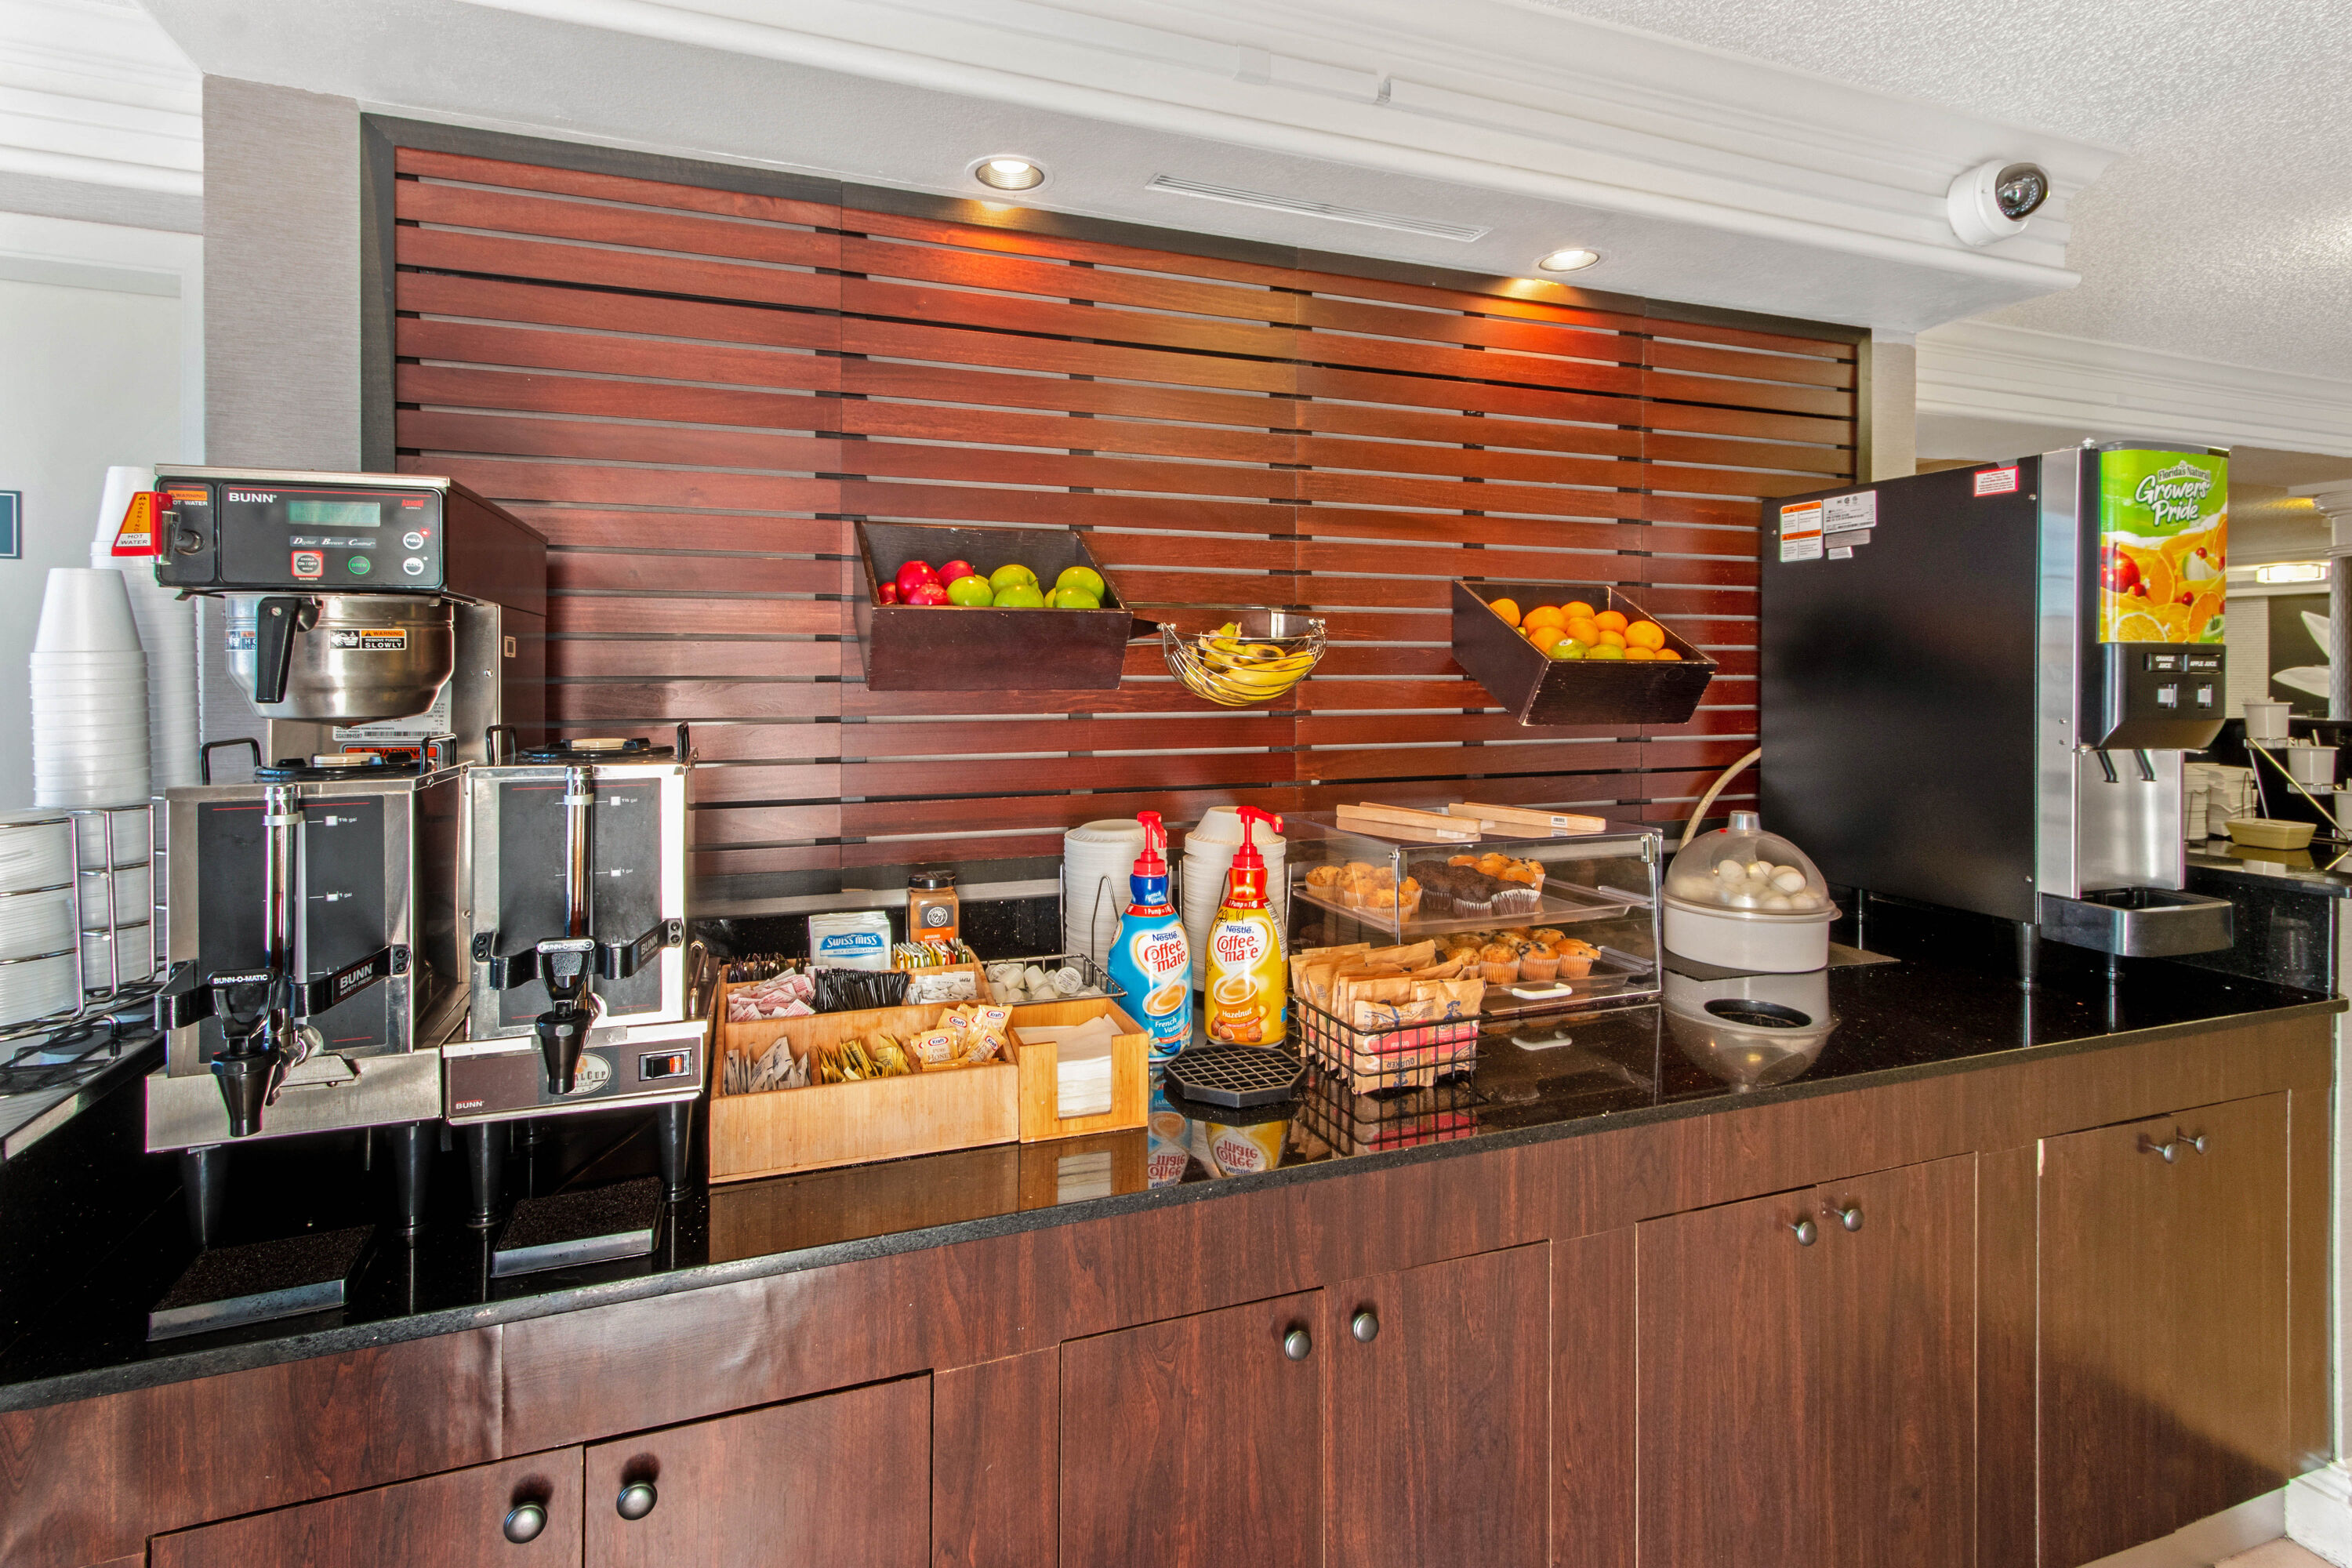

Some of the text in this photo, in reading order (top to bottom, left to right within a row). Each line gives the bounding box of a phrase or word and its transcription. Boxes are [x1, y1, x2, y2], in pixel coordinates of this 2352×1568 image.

[2187, 466, 2210, 480] Natural
[228, 492, 274, 503] BUNN
[2151, 498, 2199, 526] Pride
[641, 934, 659, 956] BUNN
[1153, 950, 1186, 972] mate
[1225, 946, 1259, 963] mae
[213, 974, 268, 984] BUNN-O-MATIC
[340, 963, 373, 989] BUNN
[1222, 1007, 1252, 1018] Hazelnut
[953, 1018, 965, 1026] Kraft
[1155, 1015, 1178, 1028] French
[456, 1101, 483, 1110] BUNN
